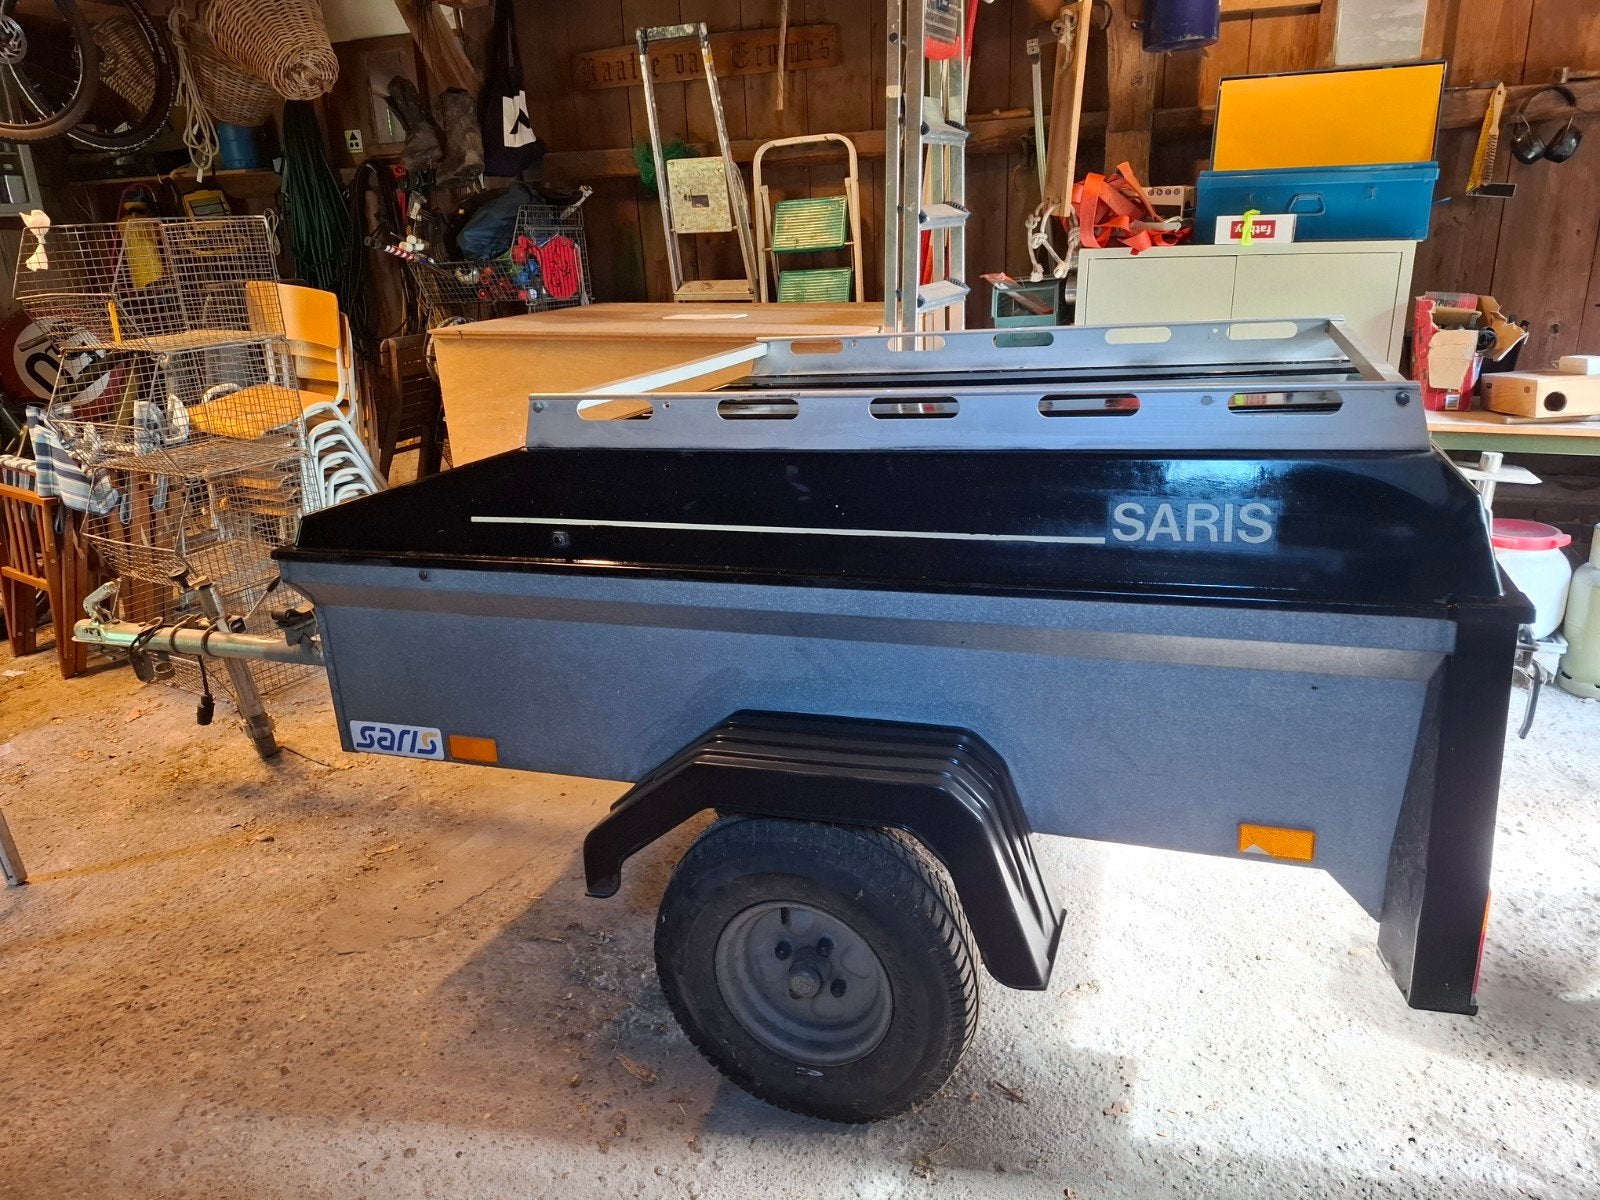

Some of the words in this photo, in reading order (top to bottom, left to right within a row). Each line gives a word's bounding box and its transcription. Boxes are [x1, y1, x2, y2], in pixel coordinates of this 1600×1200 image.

[1235, 223, 1272, 236] fatby
[1112, 502, 1273, 544] SARIS
[356, 726, 439, 755] saris
